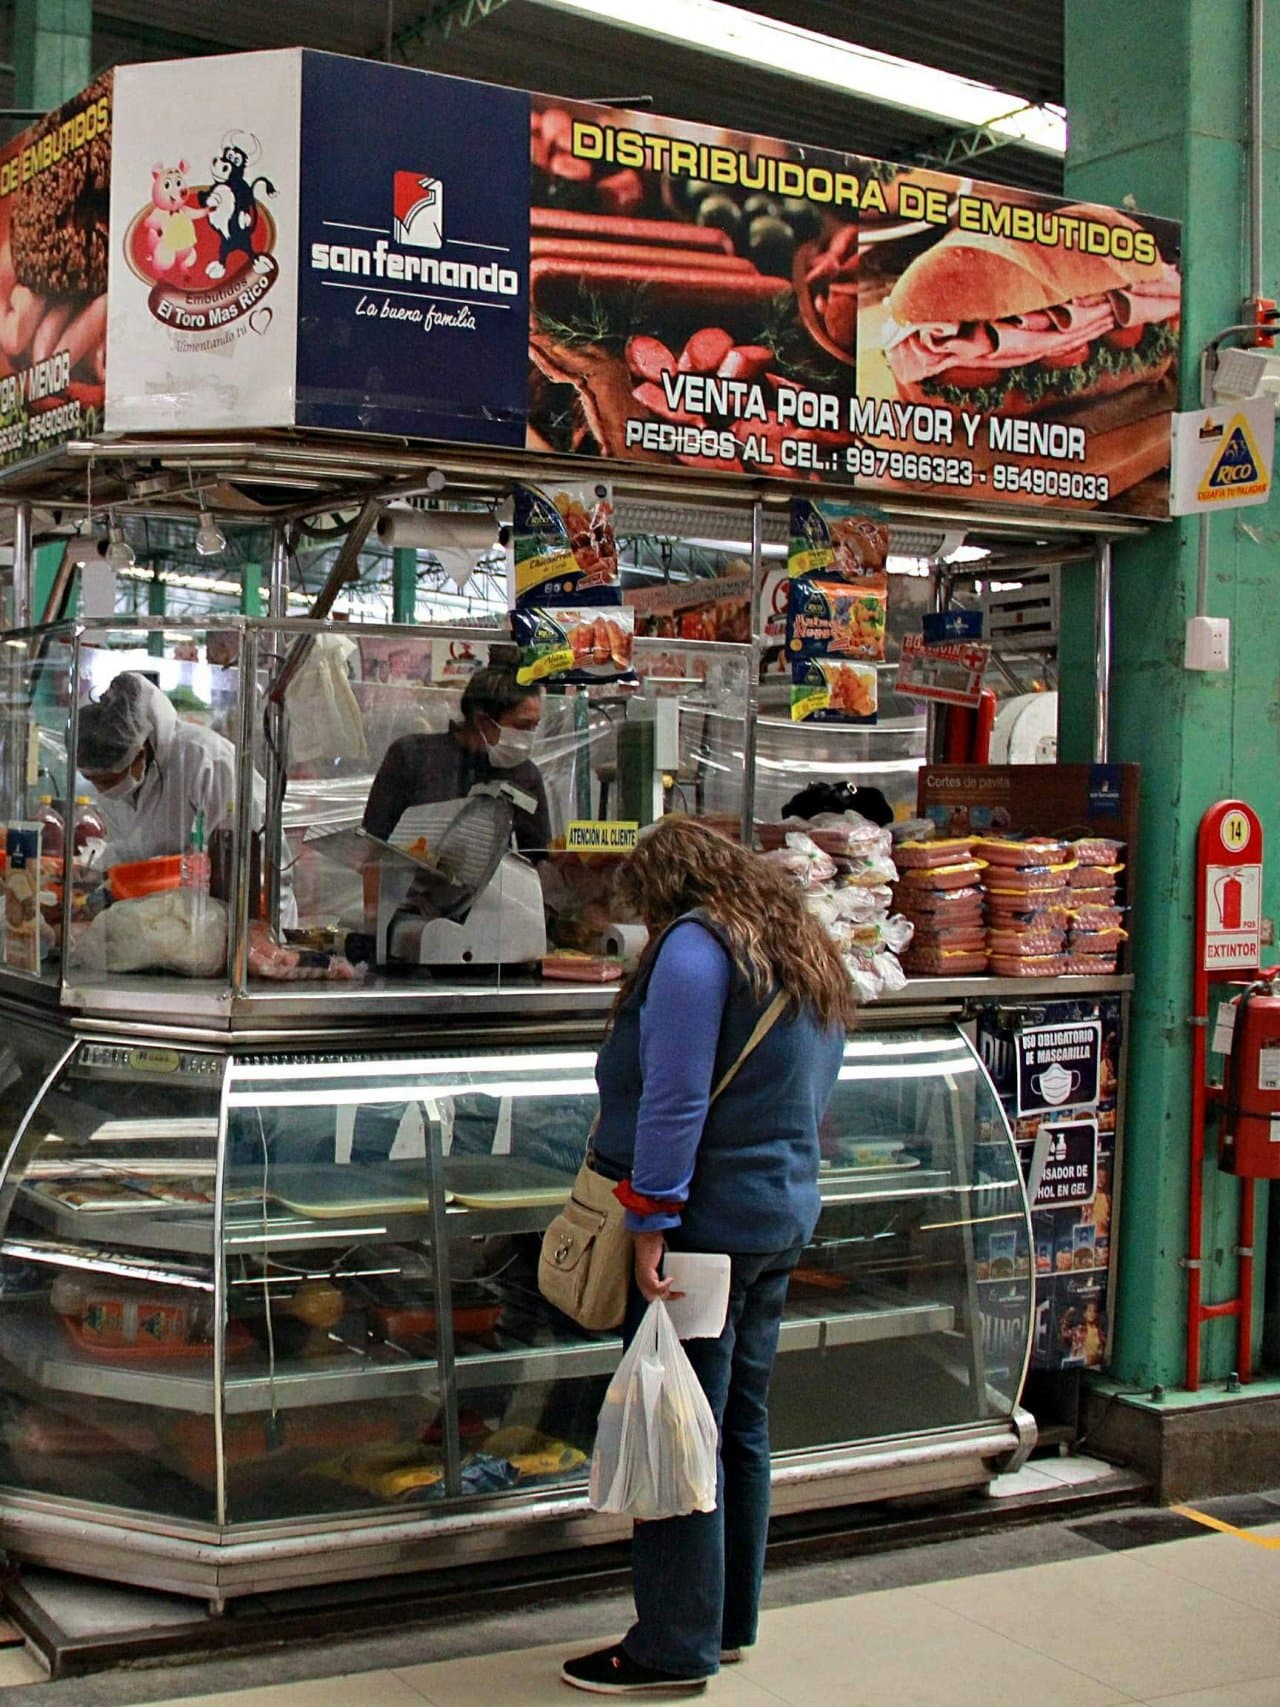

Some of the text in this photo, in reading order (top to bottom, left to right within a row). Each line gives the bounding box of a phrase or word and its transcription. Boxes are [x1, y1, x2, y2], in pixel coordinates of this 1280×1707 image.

[0, 157, 19, 196] DE
[22, 96, 110, 182] EMBUTIDOS
[572, 121, 1157, 265] DISTRIBUIDORA DE EMBUTIDOS
[157, 275, 270, 327] El Toro Mas Rico
[185, 278, 249, 305] Embutidos
[354, 295, 477, 332] La buena familia
[170, 331, 235, 353] Alimentando
[18, 370, 27, 405] Y
[28, 351, 71, 402] MENOR
[661, 370, 1087, 461] VENTA POR MAYOR Y MENOR
[625, 419, 736, 460] PEDIDOS
[742, 435, 774, 465] AL
[781, 438, 838, 471] CEL.:
[845, 447, 974, 487] 997966323
[992, 464, 1110, 501] 954909033
[1216, 463, 1252, 484] RICO
[927, 775, 961, 788] Cortes
[963, 775, 976, 788] de
[600, 828, 609, 846] AL
[610, 828, 636, 846] CLIENTE
[1230, 820, 1242, 841] 14
[1206, 942, 1257, 959] EXTINTOR
[1022, 1028, 1094, 1050] USO OBLIGATORIO
[1025, 1045, 1091, 1066] DE MASCARILLA
[1076, 1164, 1089, 1178] DE
[1056, 1183, 1069, 1197] EN
[1070, 1182, 1087, 1195] GEL
